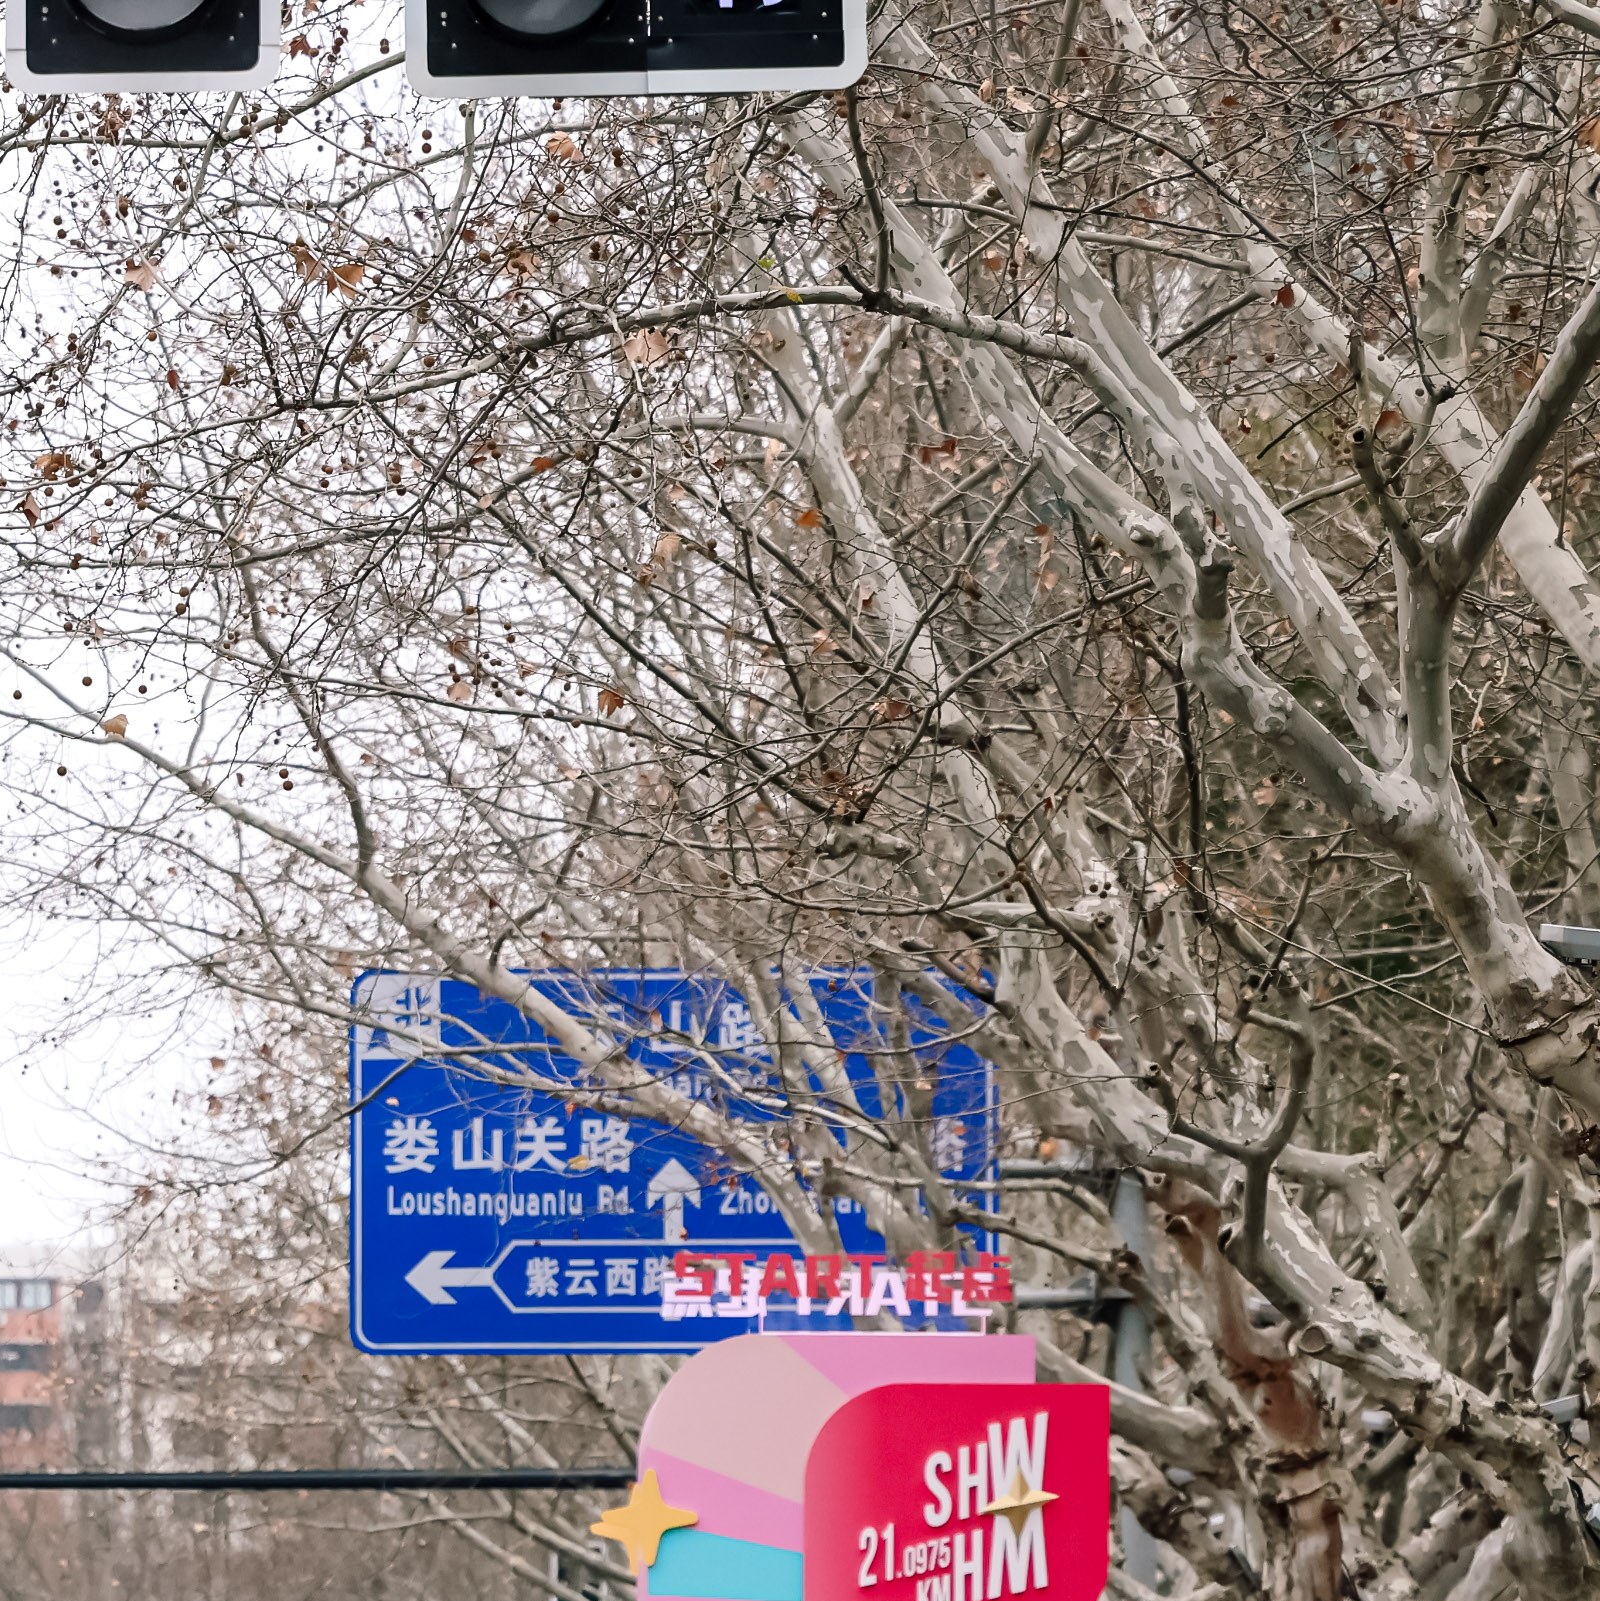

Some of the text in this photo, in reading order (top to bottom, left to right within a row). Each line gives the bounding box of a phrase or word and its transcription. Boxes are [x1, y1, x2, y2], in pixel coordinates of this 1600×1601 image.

[383, 1117, 634, 1173] 娄山关路
[387, 1185, 582, 1225] Loushanguanlu
[674, 1252, 887, 1298] START
